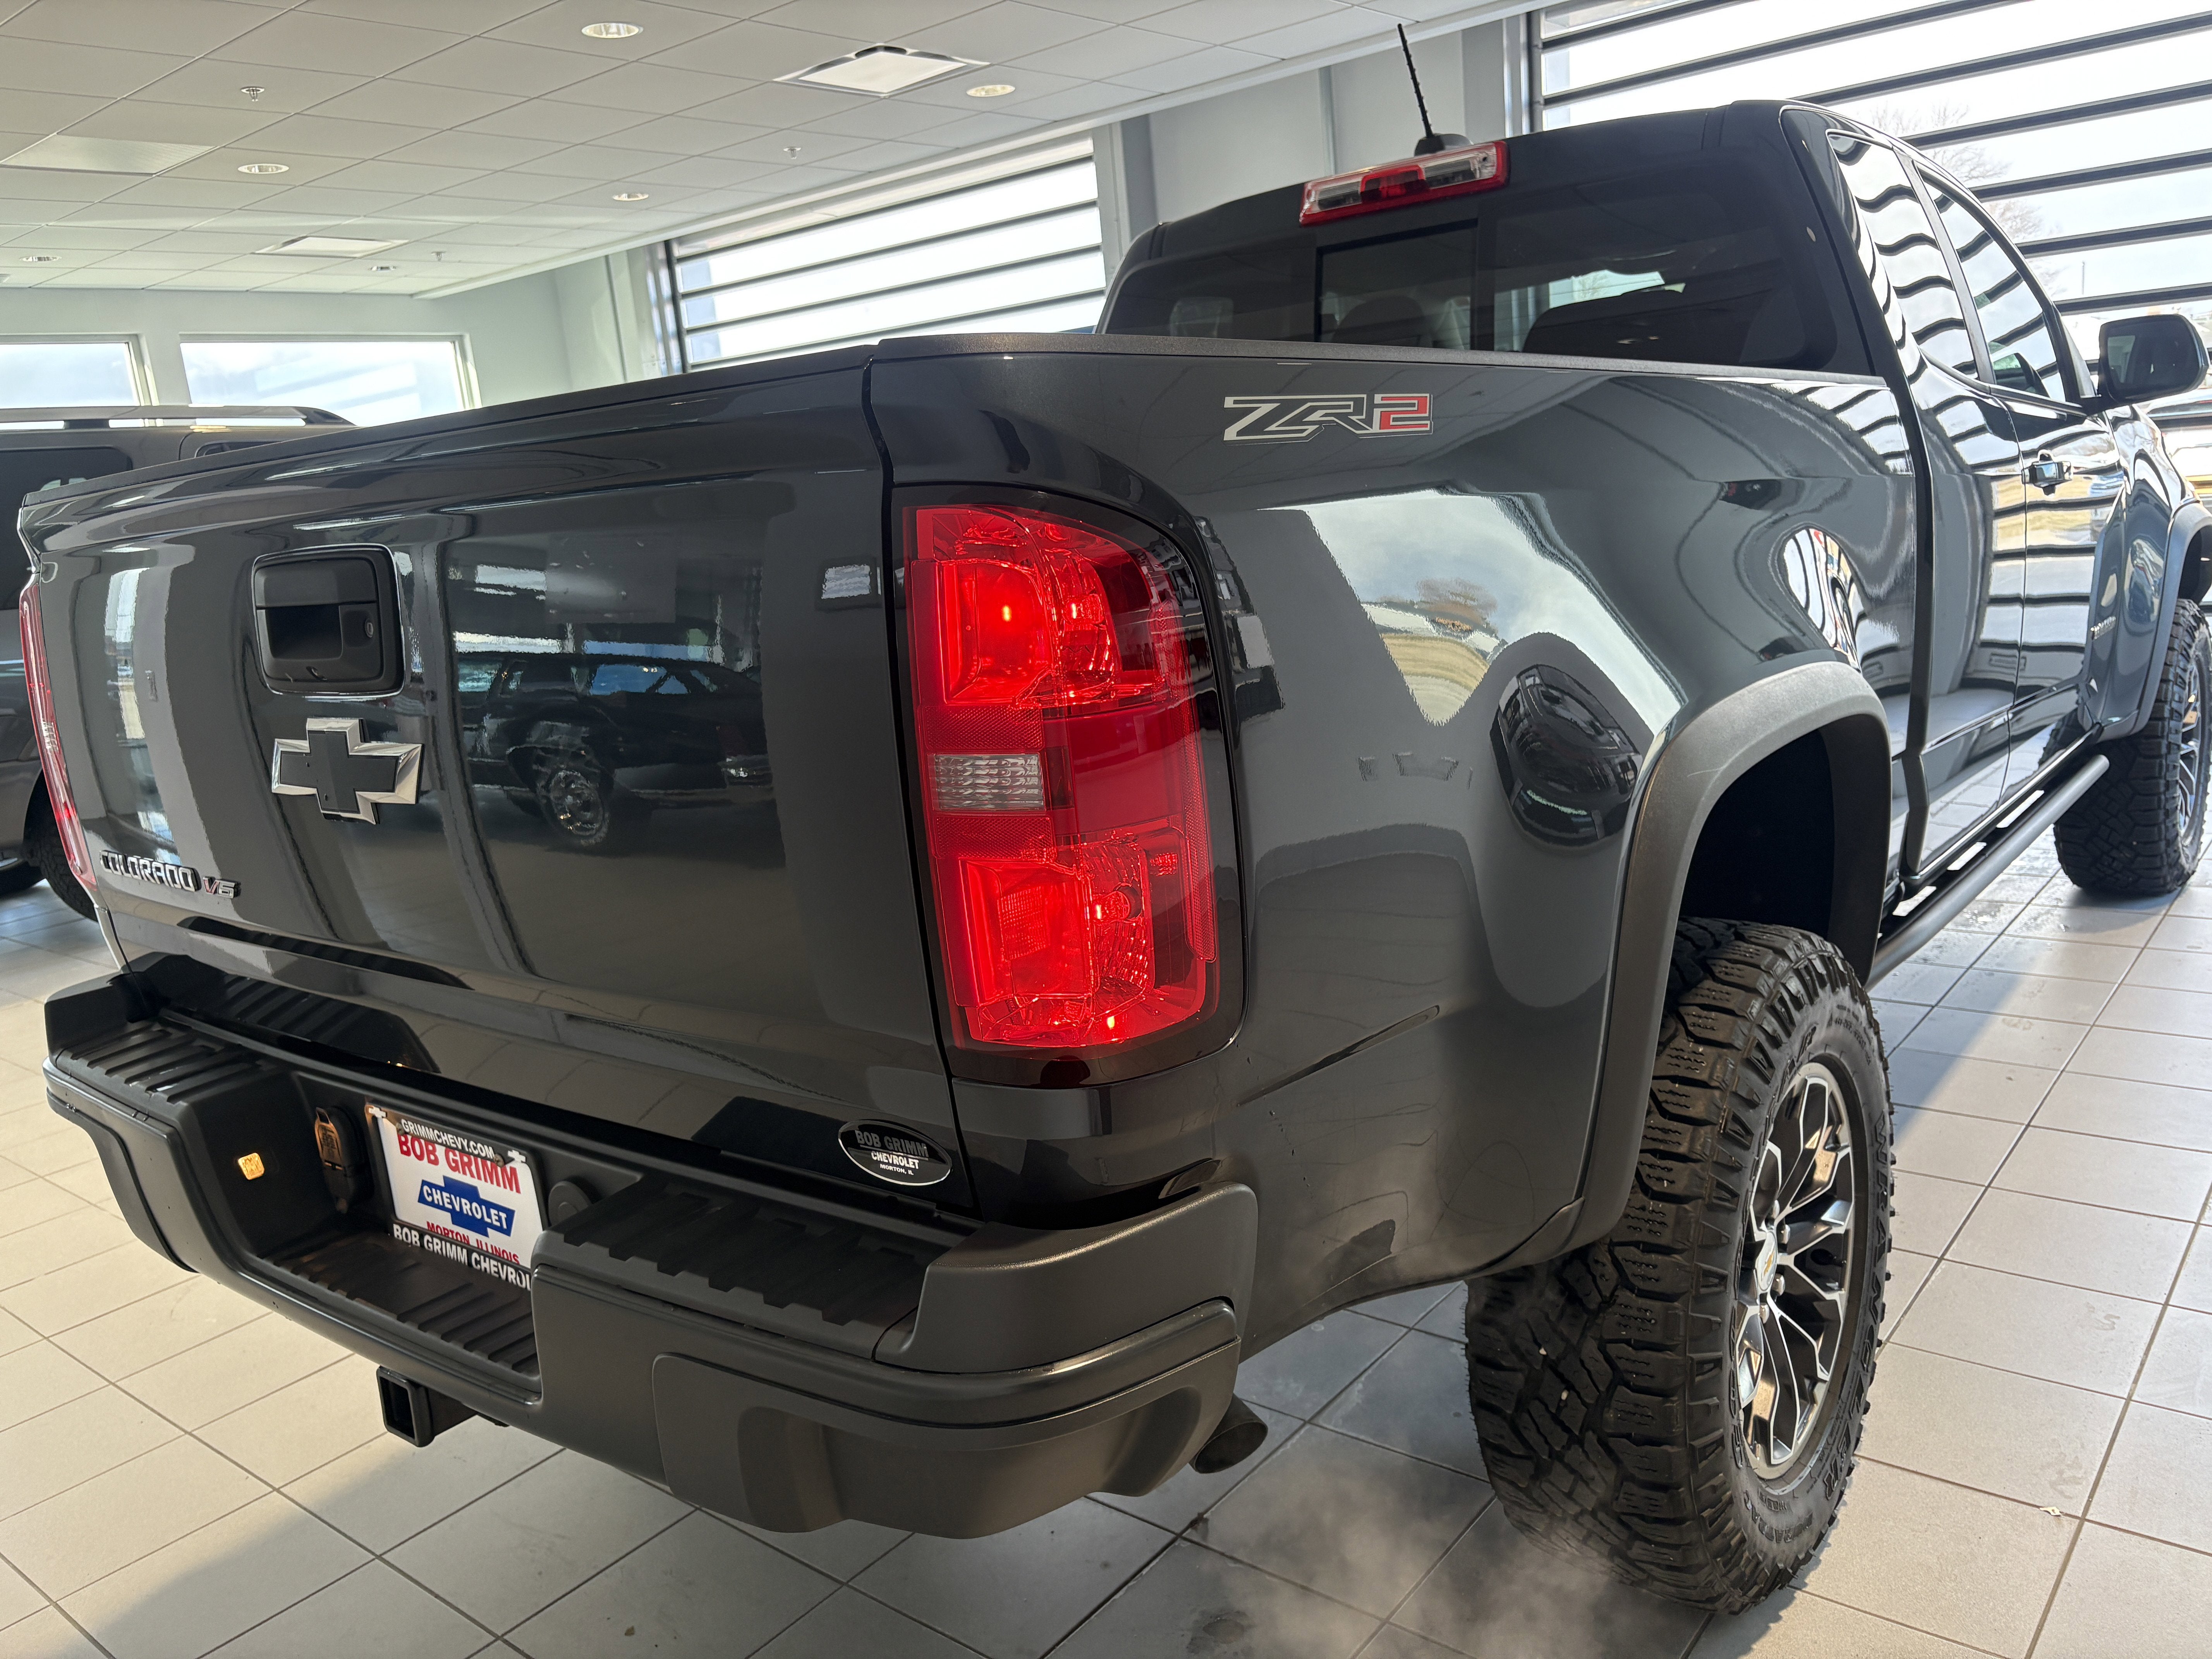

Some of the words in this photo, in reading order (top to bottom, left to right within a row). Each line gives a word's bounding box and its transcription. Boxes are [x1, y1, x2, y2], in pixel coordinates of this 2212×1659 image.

[1223, 393, 1430, 441] ZR2
[100, 850, 197, 891] COLORADO
[203, 876, 235, 899] V6
[401, 1119, 495, 1159] GRIMMCHEVY.COM
[855, 1130, 881, 1147] BOB
[884, 1136, 929, 1158] GRIMM
[871, 1151, 919, 1169] CHEVROLET
[397, 1133, 440, 1166] BOB
[445, 1147, 521, 1194] GRIMM
[880, 1163, 907, 1174] MORTON,
[423, 1185, 507, 1229] CHEVROLET
[393, 1224, 420, 1247] BOB
[424, 1235, 468, 1266] GRIMM
